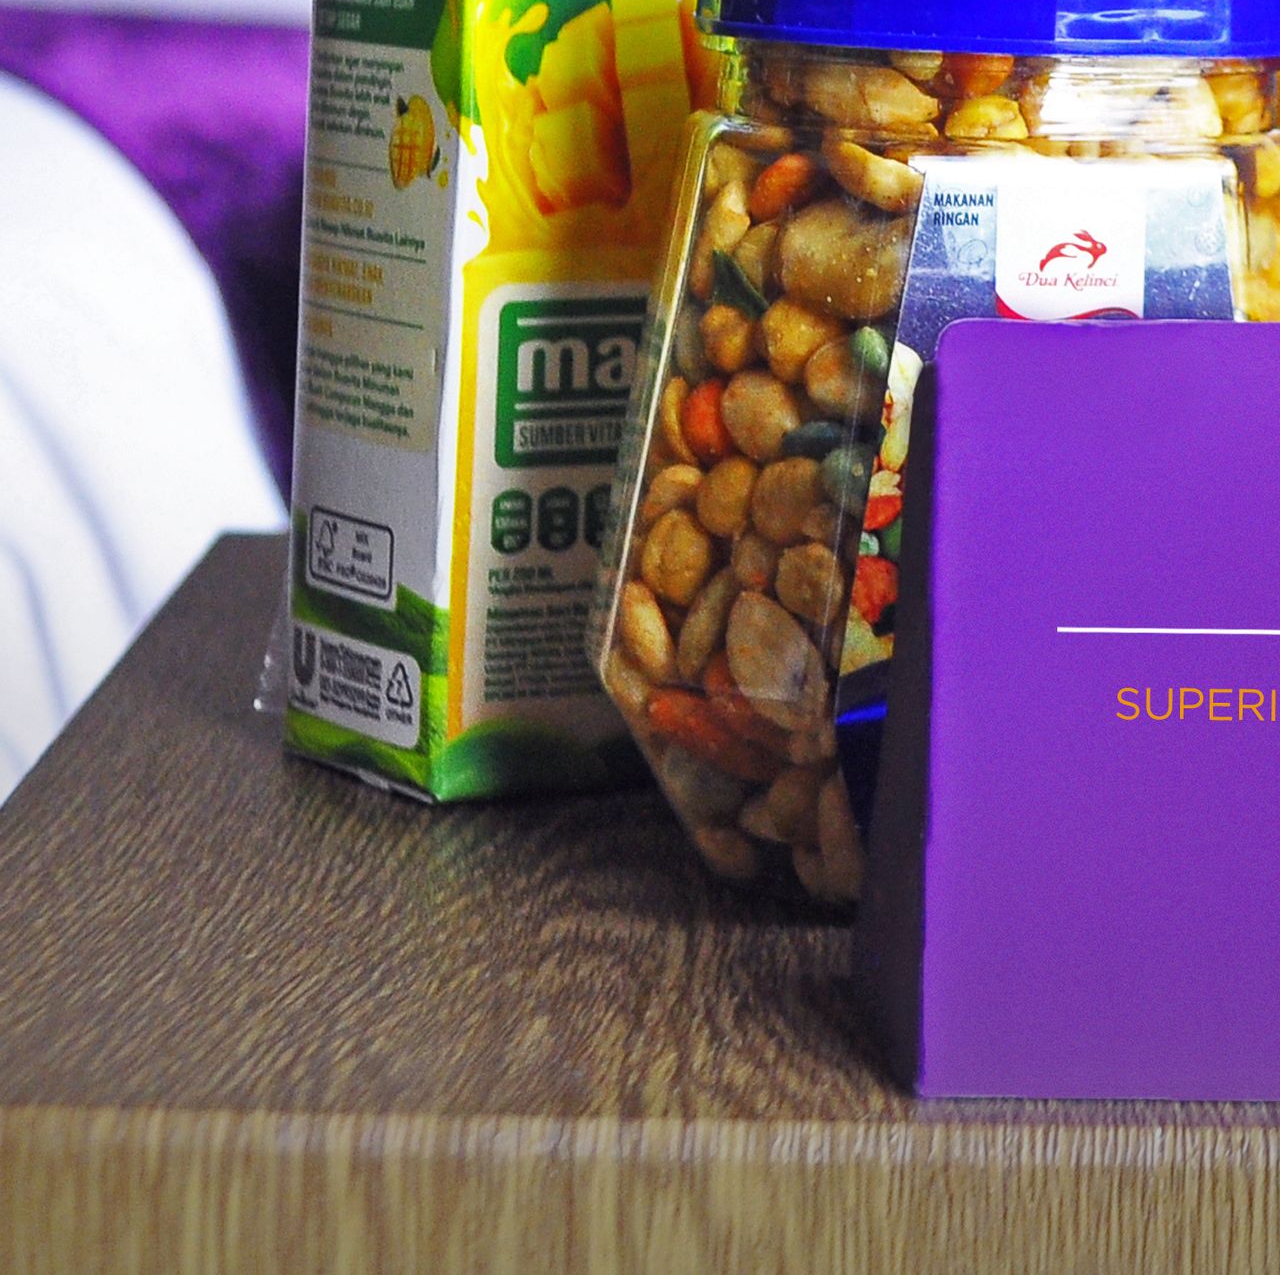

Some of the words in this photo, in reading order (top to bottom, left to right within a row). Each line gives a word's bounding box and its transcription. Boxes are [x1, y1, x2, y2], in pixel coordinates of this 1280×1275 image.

[933, 193, 994, 208] MAKANAN
[933, 212, 979, 226] RINGAN
[1018, 272, 1058, 287] Dua
[1063, 273, 1120, 292] Kelinci
[520, 423, 585, 448] SUMBER
